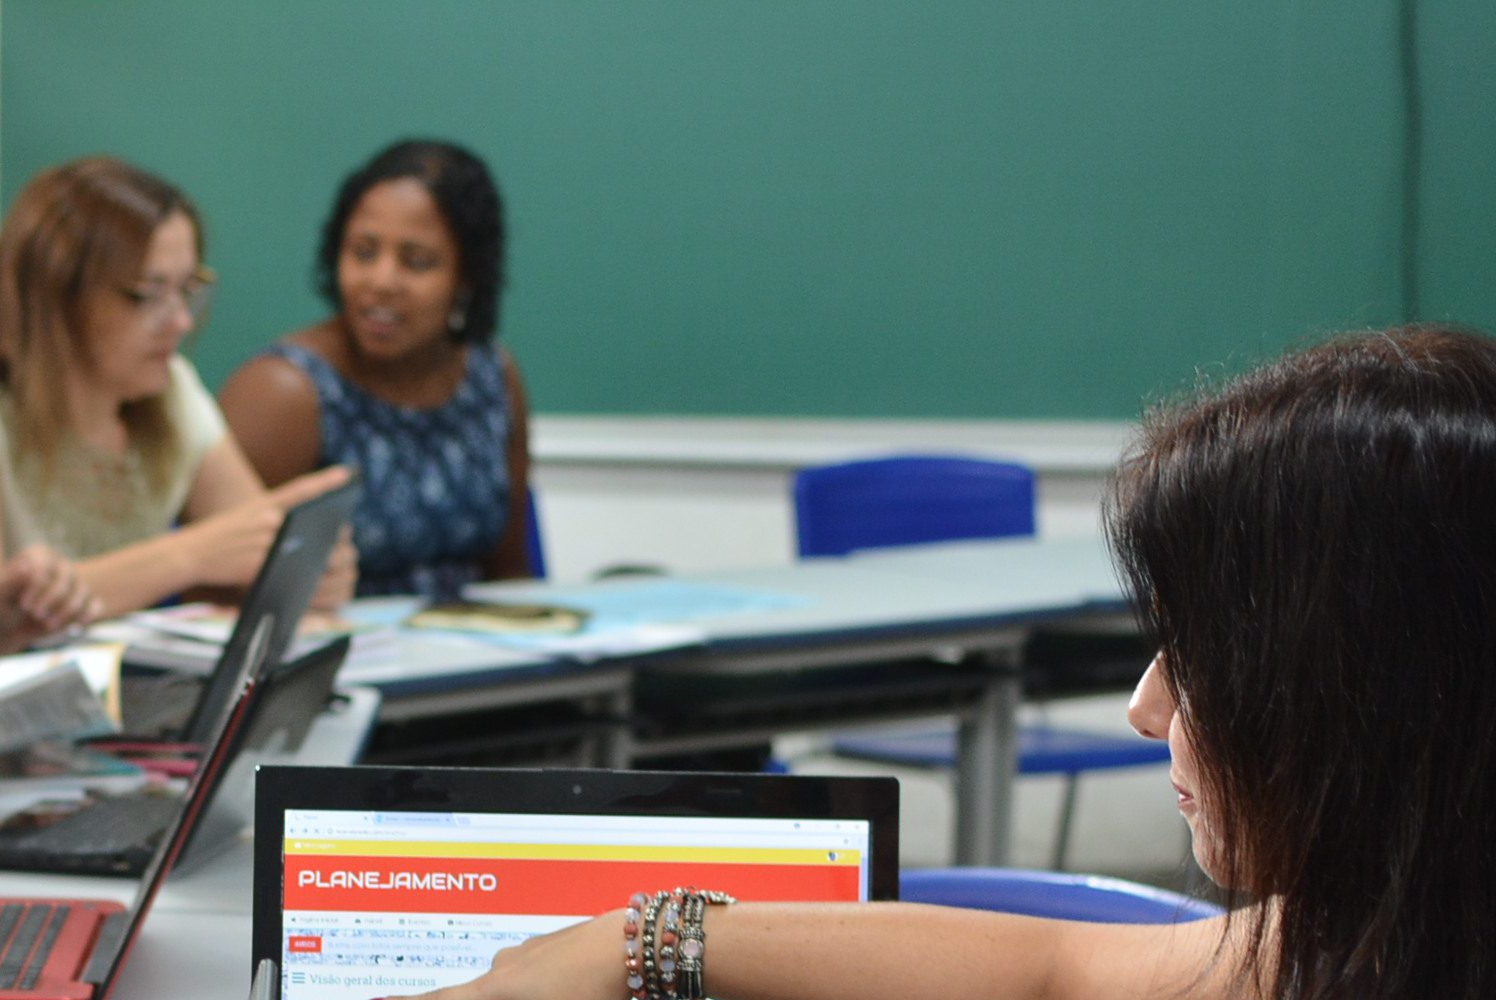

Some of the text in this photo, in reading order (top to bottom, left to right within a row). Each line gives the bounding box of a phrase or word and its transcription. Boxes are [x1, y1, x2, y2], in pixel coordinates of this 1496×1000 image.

[298, 870, 497, 892] PLANEJAMENTO
[309, 973, 437, 989] Visão geral dos cursos
